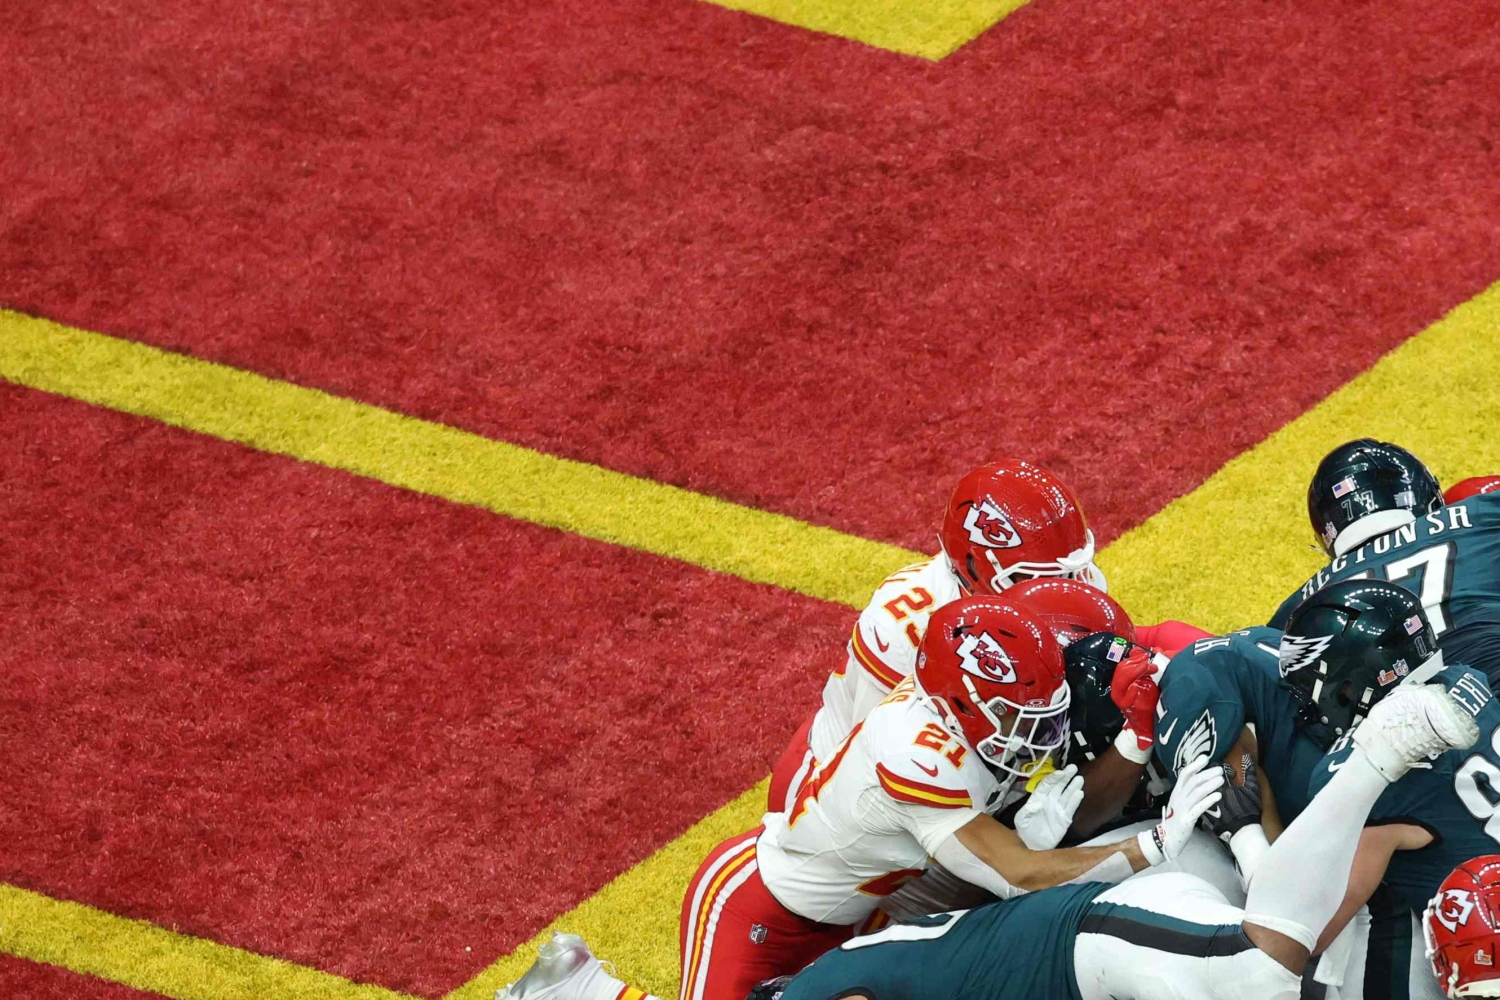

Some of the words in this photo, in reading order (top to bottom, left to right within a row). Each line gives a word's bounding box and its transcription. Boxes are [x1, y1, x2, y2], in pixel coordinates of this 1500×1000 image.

[1425, 504, 1473, 536] SR
[1449, 672, 1493, 718] ERT
[912, 722, 970, 771] 21
